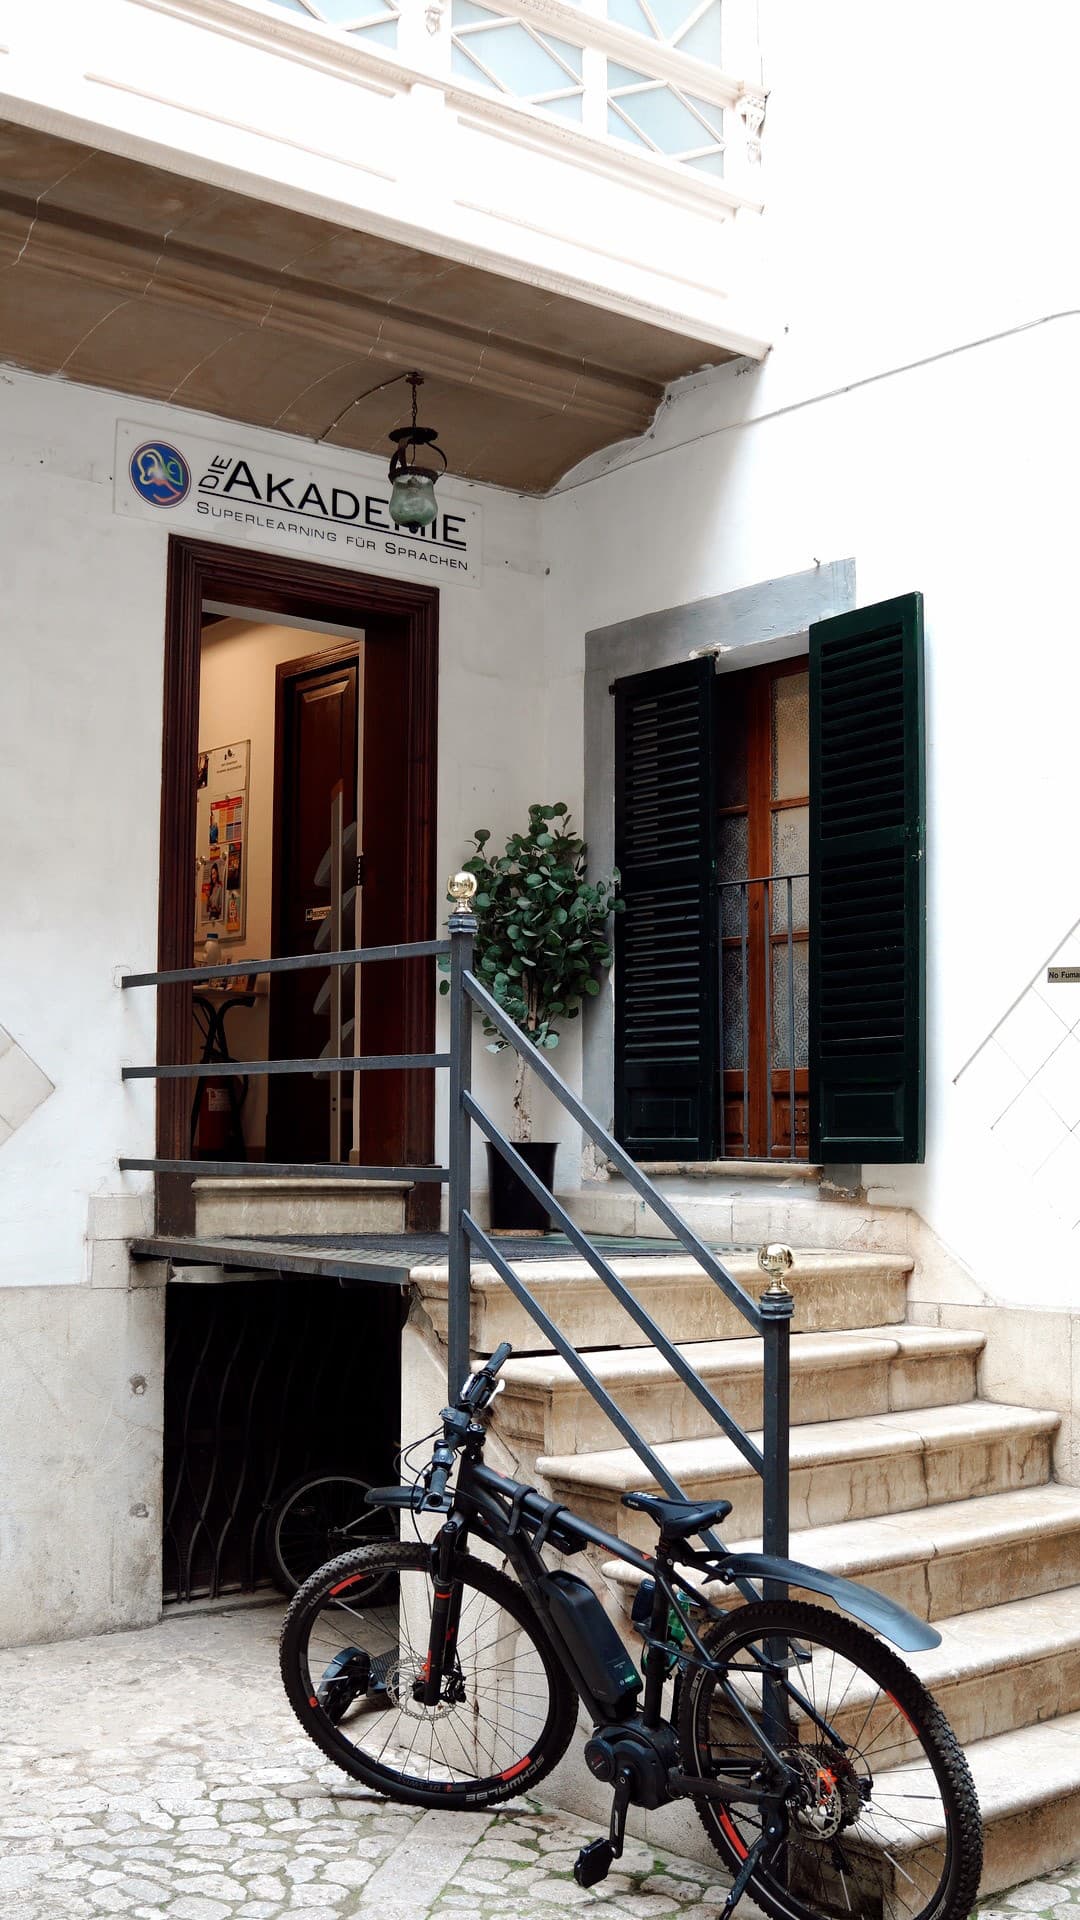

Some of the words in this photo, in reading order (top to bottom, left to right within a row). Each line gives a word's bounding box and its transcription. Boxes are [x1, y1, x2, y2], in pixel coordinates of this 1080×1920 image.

[198, 455, 232, 490] DIE
[223, 460, 467, 547] AKADEIE
[1048, 971, 1058, 979] No
[465, 1753, 545, 1802] SCHWALBE
